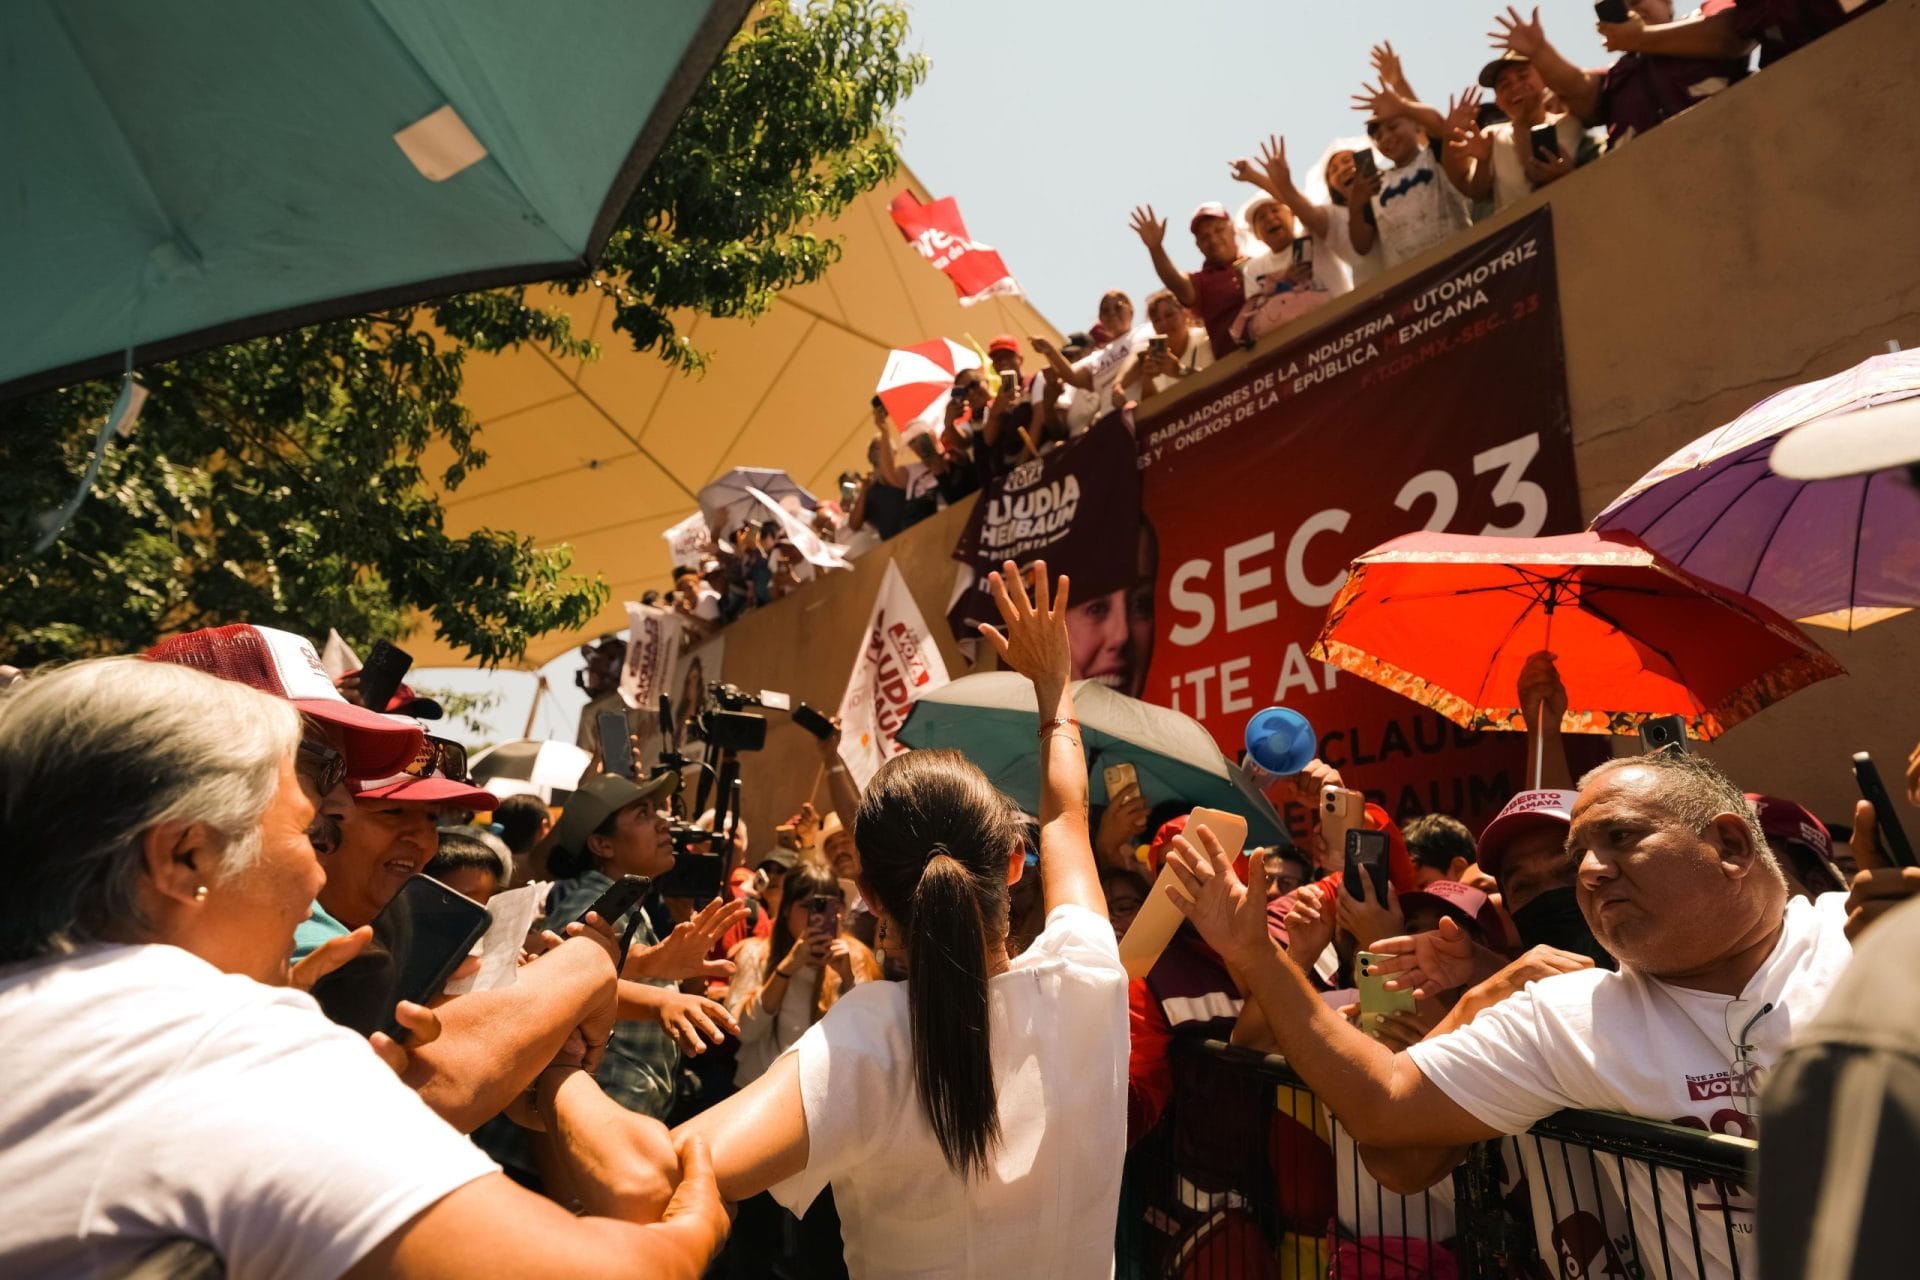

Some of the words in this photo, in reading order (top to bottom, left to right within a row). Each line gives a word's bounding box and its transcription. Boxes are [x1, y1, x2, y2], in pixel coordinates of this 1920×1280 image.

[1146, 385, 1250, 446] RABAJADORES
[1253, 372, 1274, 394] DE
[1278, 362, 1299, 381] LA
[1304, 313, 1395, 368] NDUSTRIA
[1167, 413, 1232, 453] ONEXOS
[1235, 401, 1255, 422] DE
[1259, 391, 1279, 410] LA
[1284, 342, 1380, 396] EPÚBLICA
[1168, 508, 1351, 647] SEC
[1394, 432, 1548, 538] 23
[1519, 800, 1562, 812] AMAYA
